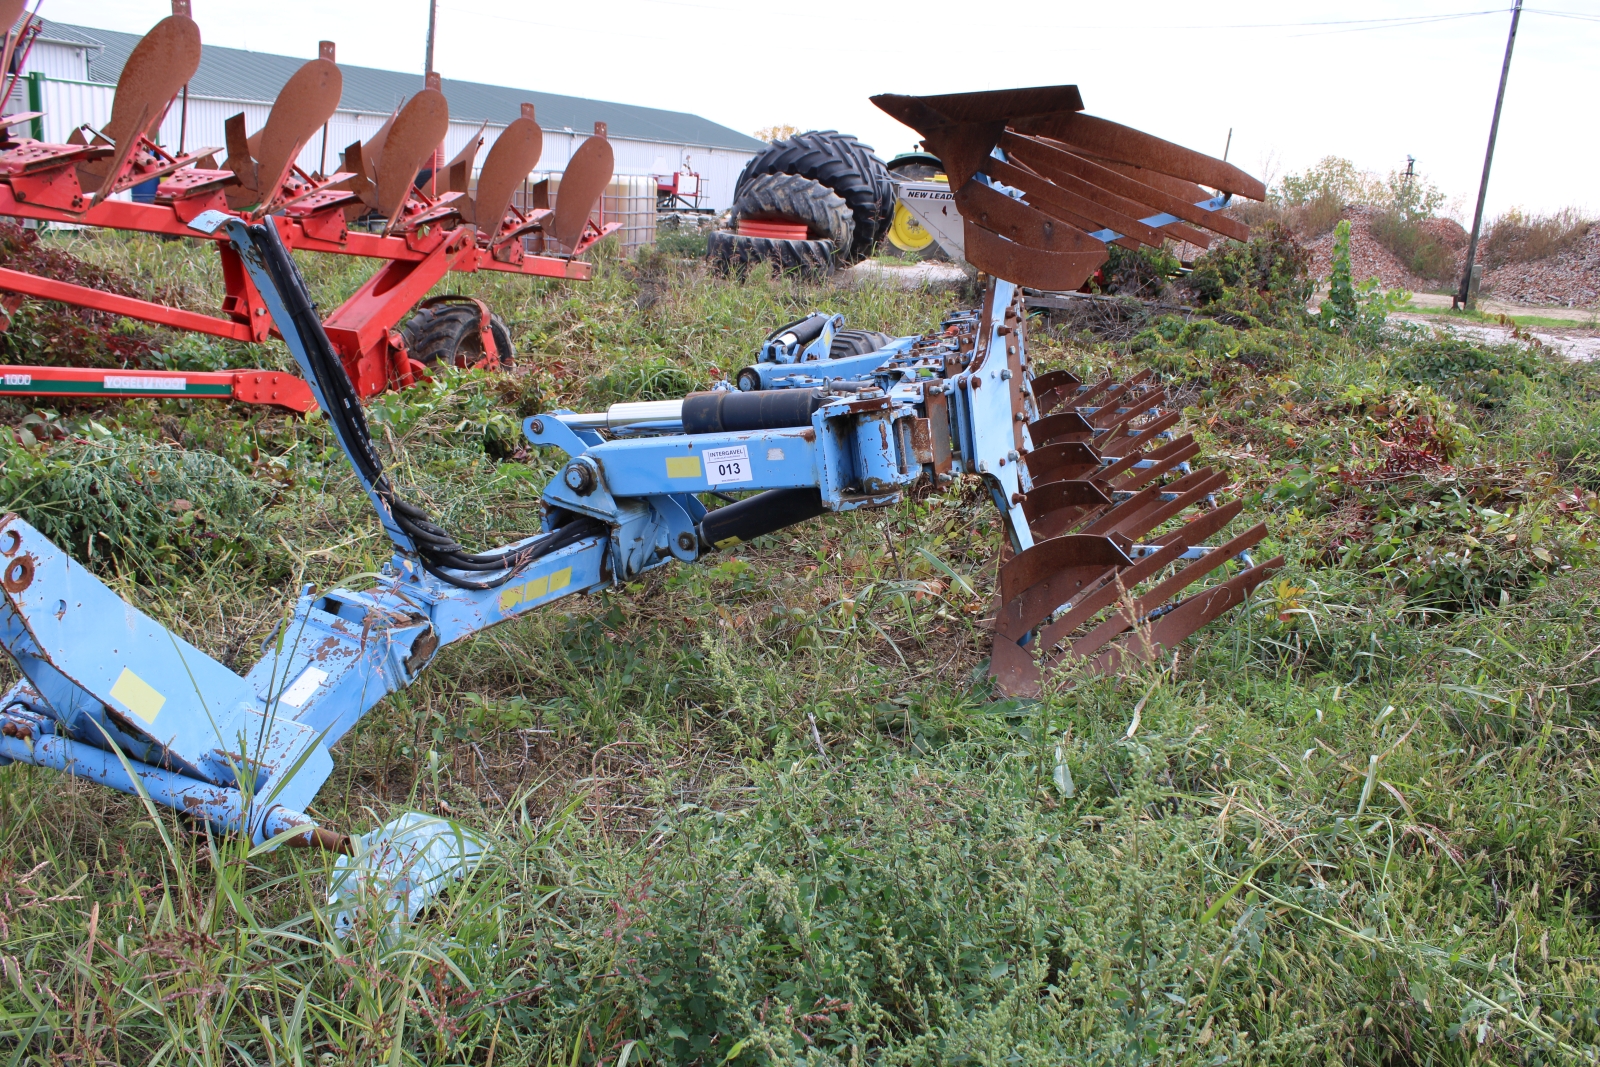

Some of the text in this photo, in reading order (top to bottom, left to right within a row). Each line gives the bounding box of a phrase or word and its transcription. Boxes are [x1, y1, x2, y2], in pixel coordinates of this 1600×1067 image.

[908, 191, 928, 199] NEW
[5, 374, 31, 385] 1000
[105, 376, 142, 387] VOGEL
[709, 449, 744, 458] INTERGAVEL
[718, 462, 741, 476] 013
